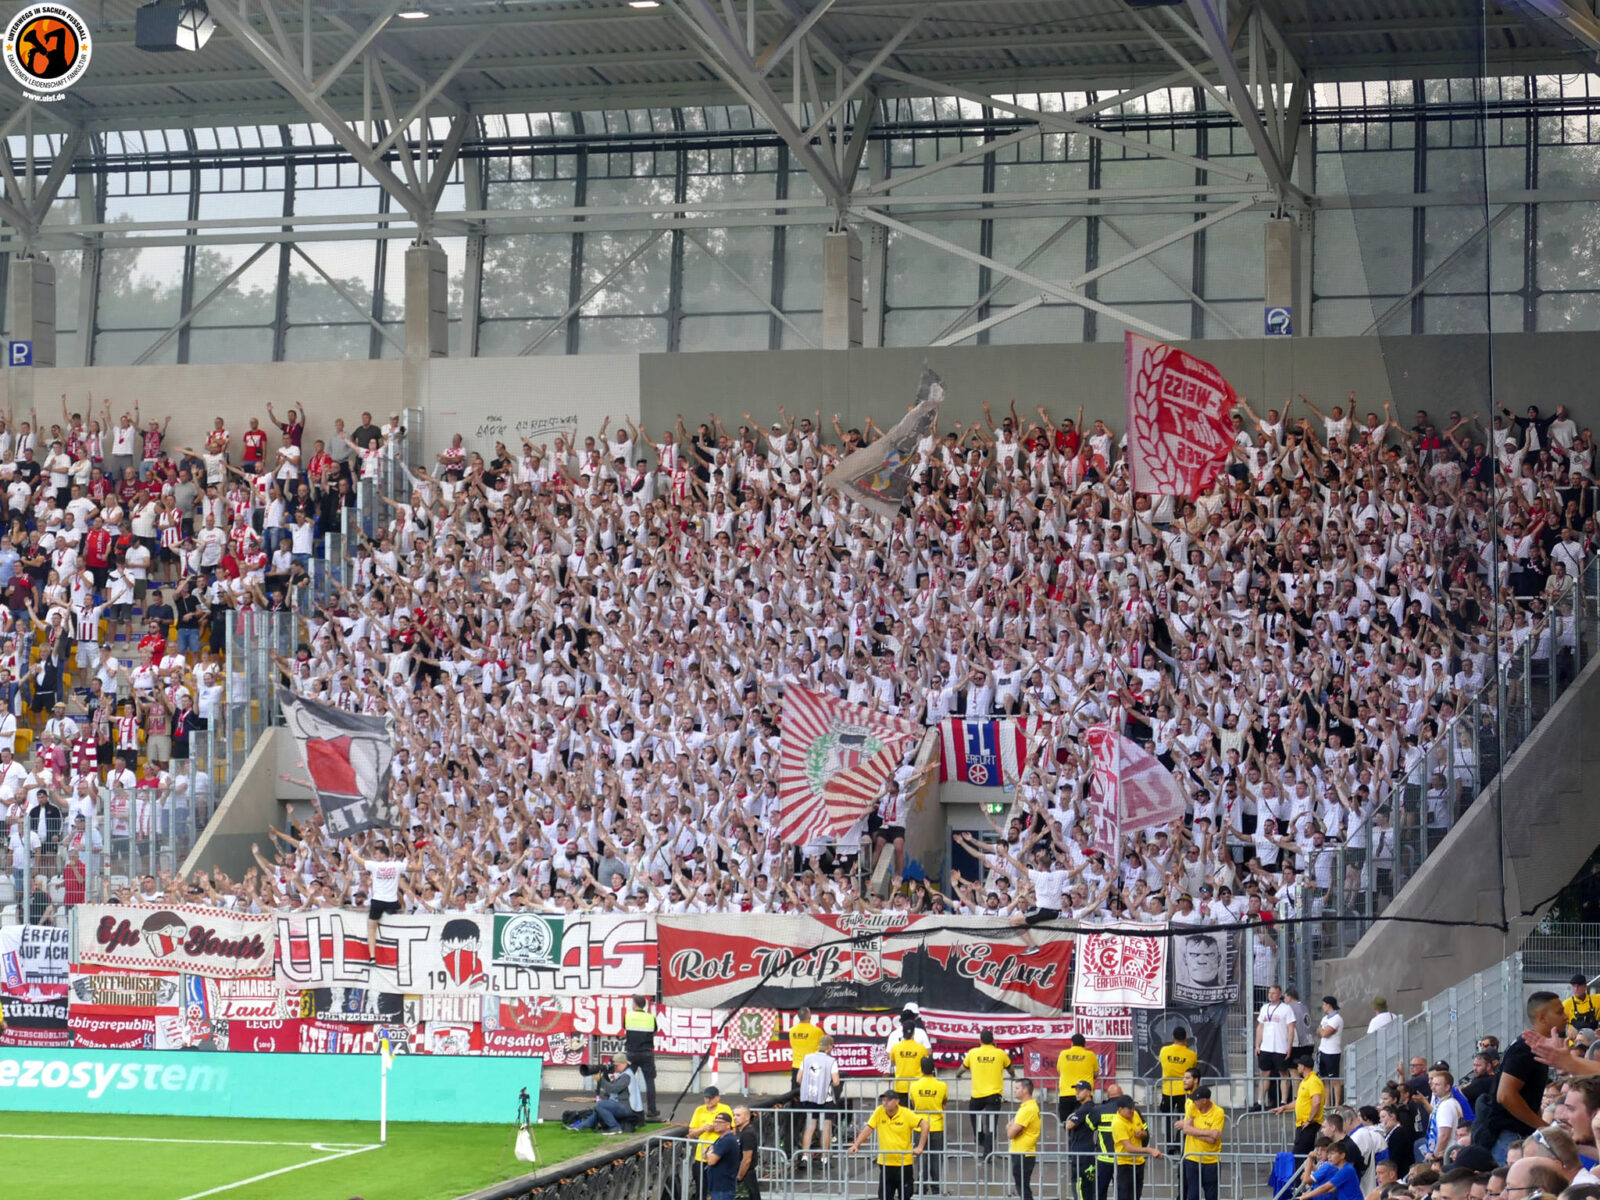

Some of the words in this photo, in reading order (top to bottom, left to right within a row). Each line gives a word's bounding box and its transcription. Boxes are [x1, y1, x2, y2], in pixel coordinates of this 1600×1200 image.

[965, 754, 997, 766] ERFURT
[185, 924, 266, 960] Youth
[1097, 937, 1118, 947] HFC
[1130, 940, 1142, 949] FC
[19, 945, 41, 960] AUF
[1125, 946, 1145, 958] RWE
[956, 943, 1058, 990] Erfurt
[428, 970, 448, 990] 19
[481, 973, 500, 991] 96
[1097, 977, 1120, 989] ERFURT
[222, 1001, 277, 1018] Land
[316, 1011, 393, 1022] GRENZGEBIET
[422, 997, 481, 1021] BERLIN
[1085, 1007, 1126, 1017] GRUPPE
[245, 1020, 283, 1029] LEGIO
[823, 1015, 901, 1037] CHICOS
[1076, 1018, 1094, 1036] ILM
[484, 1031, 545, 1048] Versatio
[743, 1048, 793, 1064] GEHR
[830, 1046, 868, 1057] übbloch
[0, 1059, 229, 1099] ezosystem
